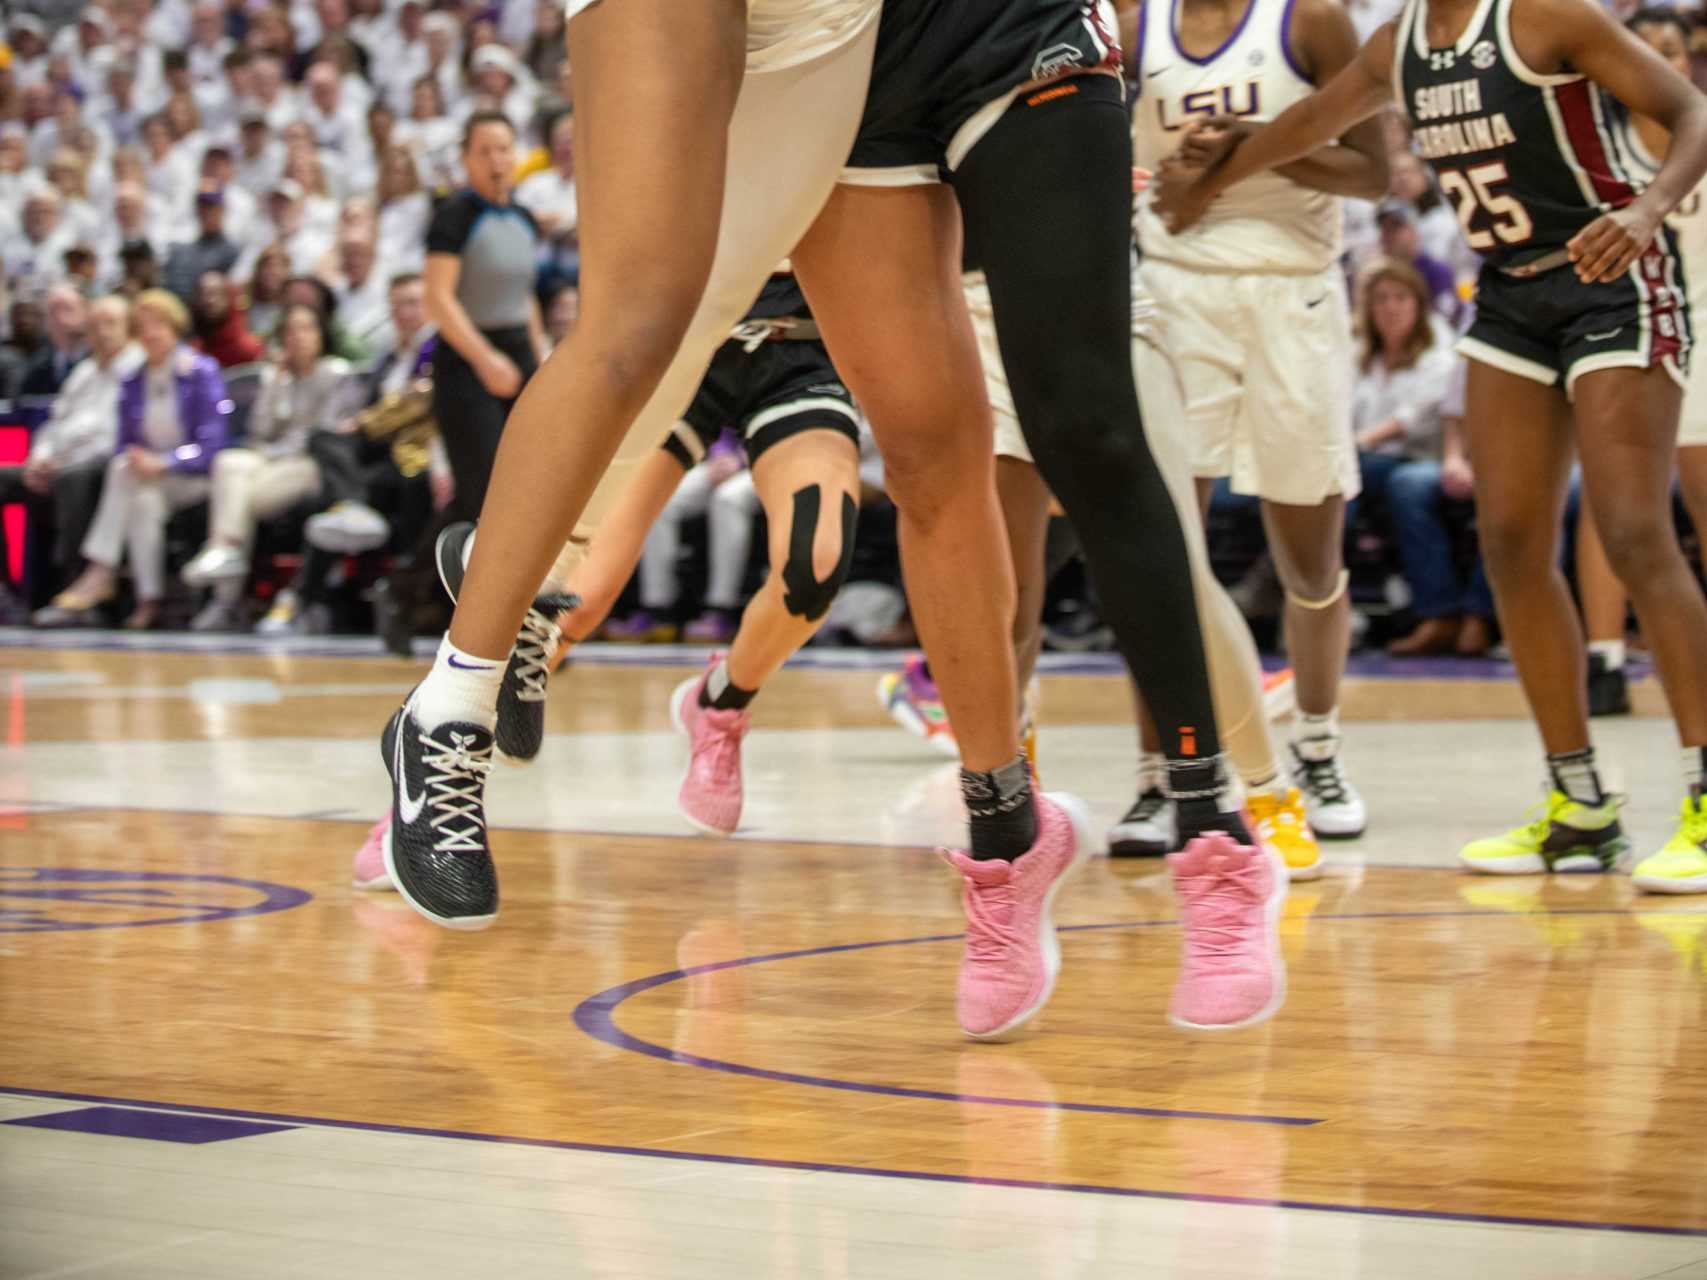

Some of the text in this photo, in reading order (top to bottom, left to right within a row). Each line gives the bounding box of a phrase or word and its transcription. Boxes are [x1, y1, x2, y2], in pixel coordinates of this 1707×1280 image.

[1158, 82, 1260, 131] LSU
[1414, 78, 1482, 120] SOUTH
[1439, 160, 1533, 249] 25
